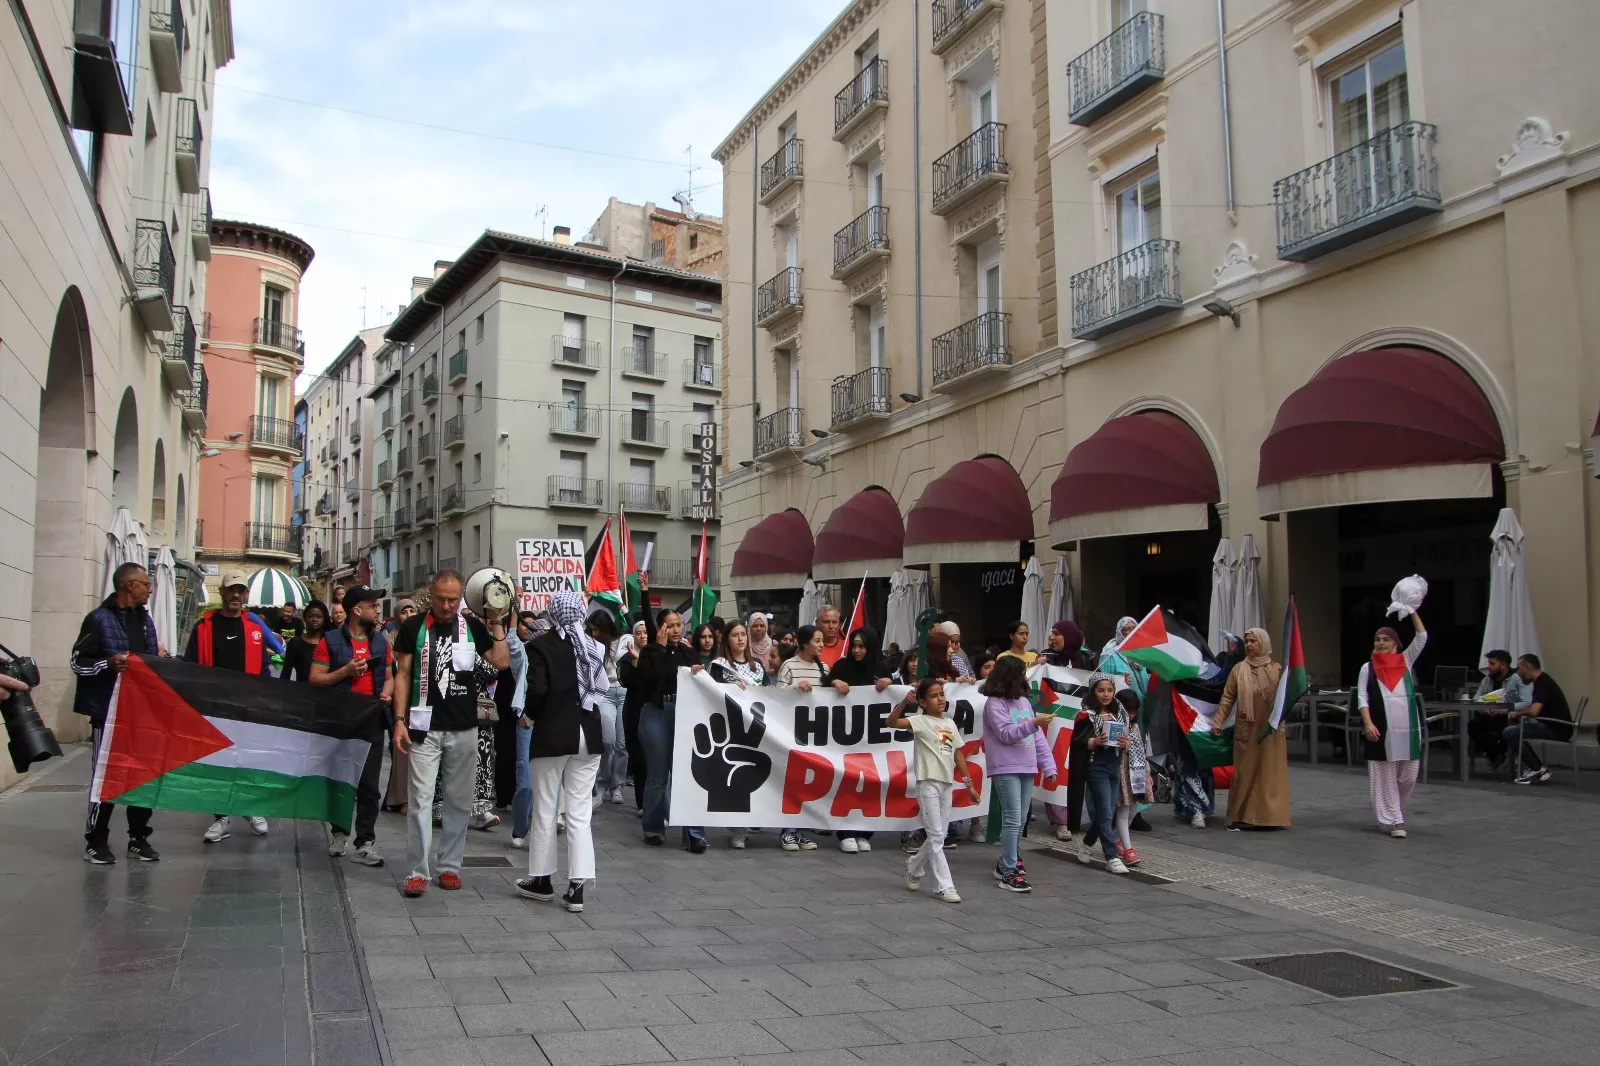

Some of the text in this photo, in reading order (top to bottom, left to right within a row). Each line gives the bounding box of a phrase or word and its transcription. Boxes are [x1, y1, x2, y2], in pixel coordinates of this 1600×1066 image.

[702, 424, 714, 503] HOSTAL
[519, 541, 582, 557] ISRAEL
[520, 558, 584, 574] GENOCIDA
[522, 576, 575, 592] EUROPA
[420, 642, 429, 698] PALESTINE
[794, 699, 974, 746] HUESA
